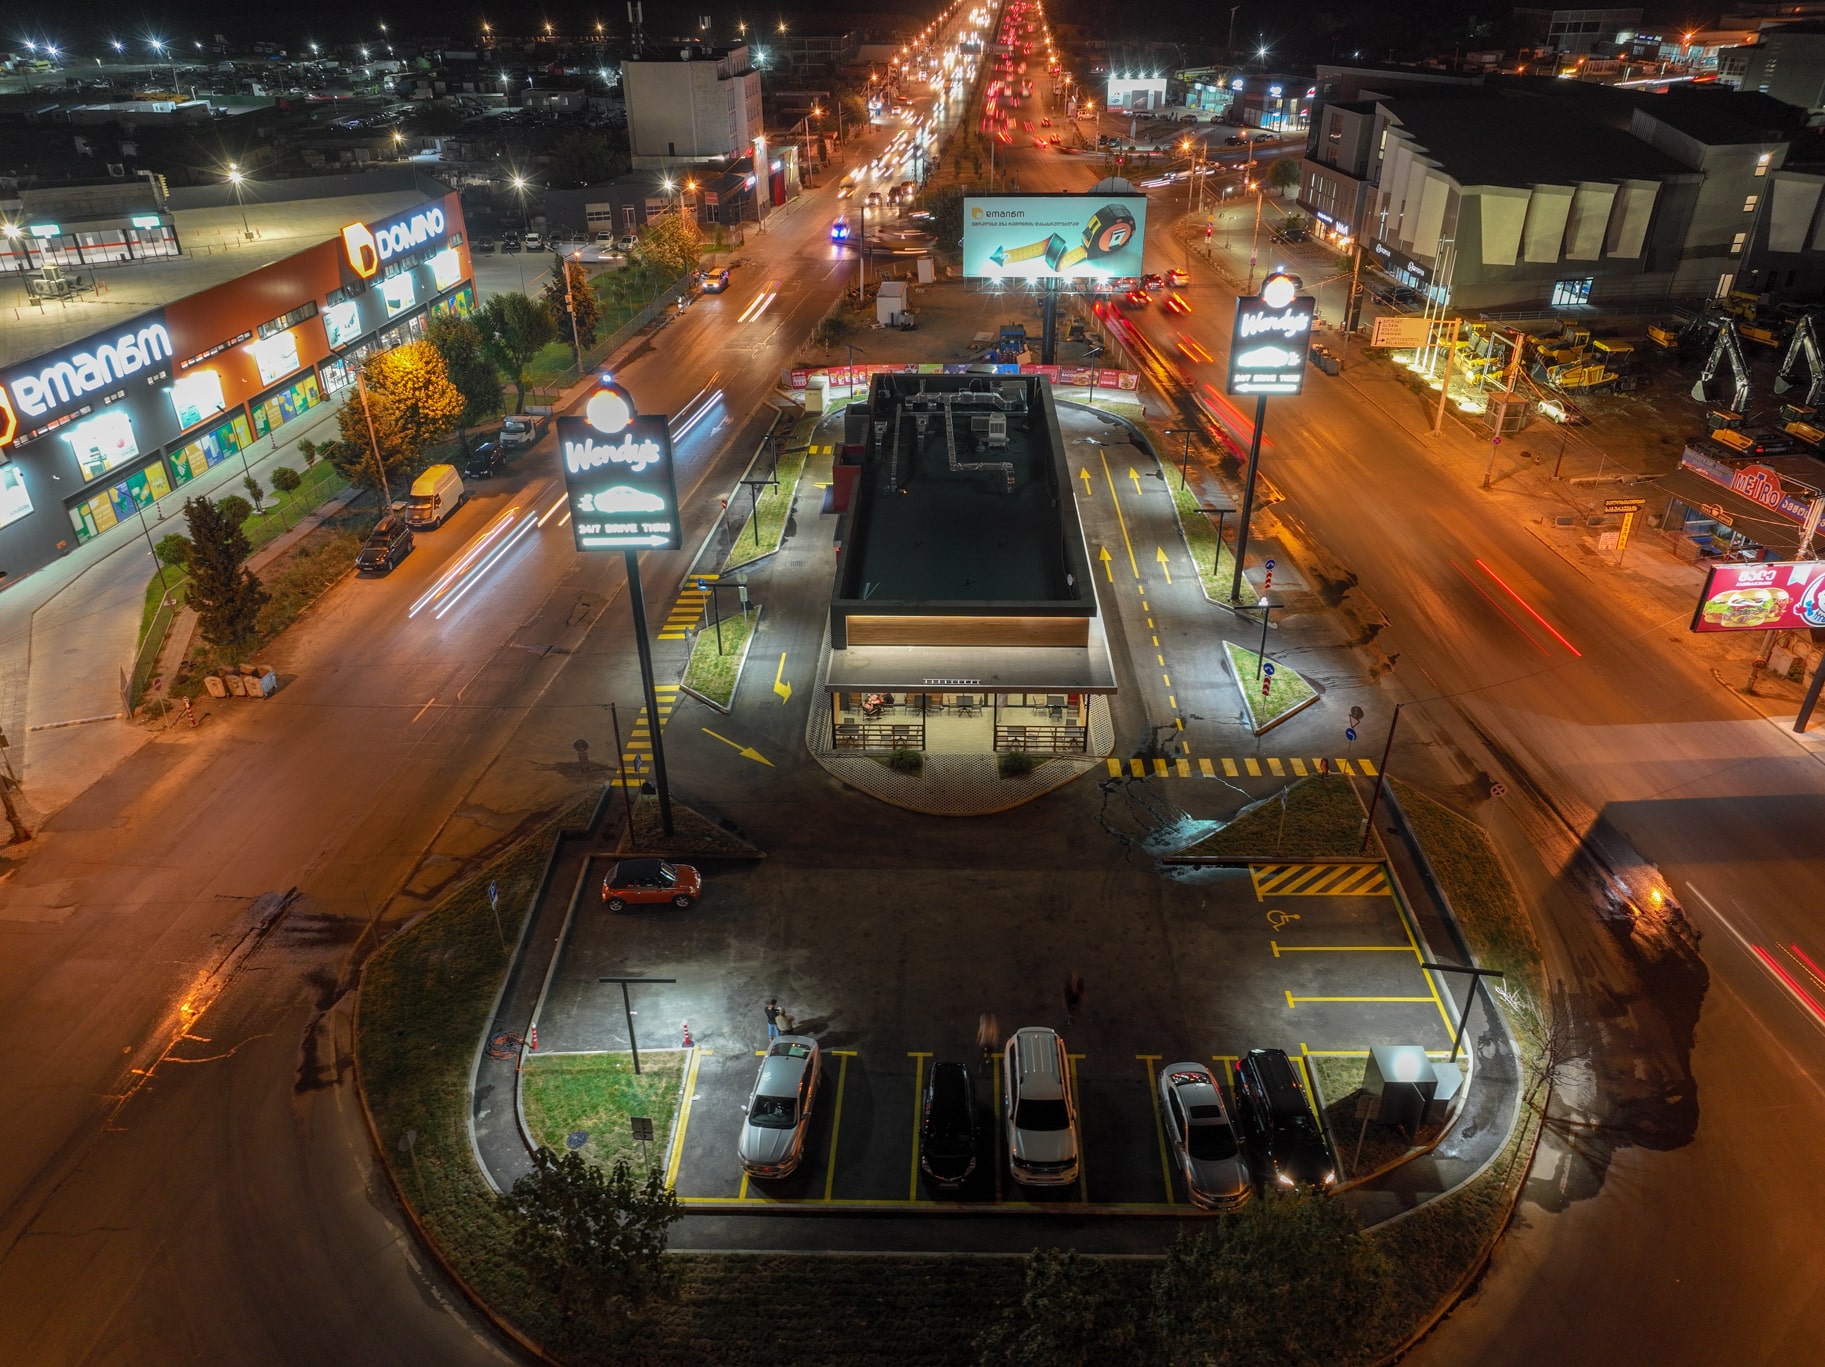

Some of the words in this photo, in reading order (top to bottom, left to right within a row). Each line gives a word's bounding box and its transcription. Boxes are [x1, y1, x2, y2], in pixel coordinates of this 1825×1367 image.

[375, 208, 445, 260] DOMINO
[1240, 308, 1309, 338] Wendy's
[565, 433, 660, 473] Wendy's
[1735, 472, 1780, 507] METRO
[578, 524, 601, 534] 24/7
[604, 523, 638, 533] DRIVE
[641, 522, 671, 533] THRU
